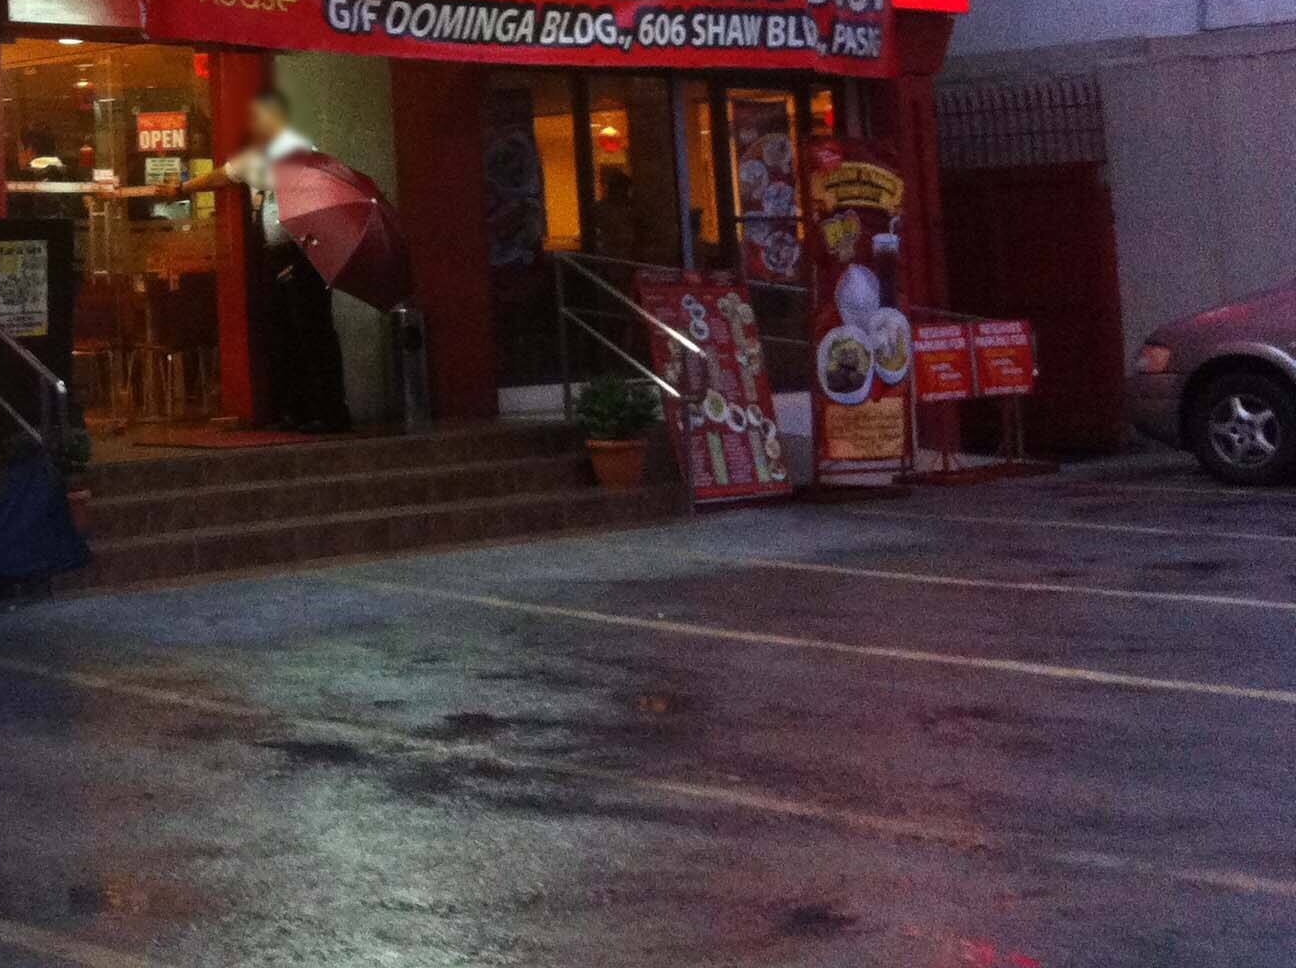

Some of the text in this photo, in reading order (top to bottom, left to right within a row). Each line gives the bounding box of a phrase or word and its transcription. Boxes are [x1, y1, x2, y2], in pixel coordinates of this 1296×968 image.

[385, 0, 536, 44] DOMINGA
[638, 12, 686, 46] 606
[691, 12, 762, 47] SHAW
[139, 128, 185, 150] OPEN
